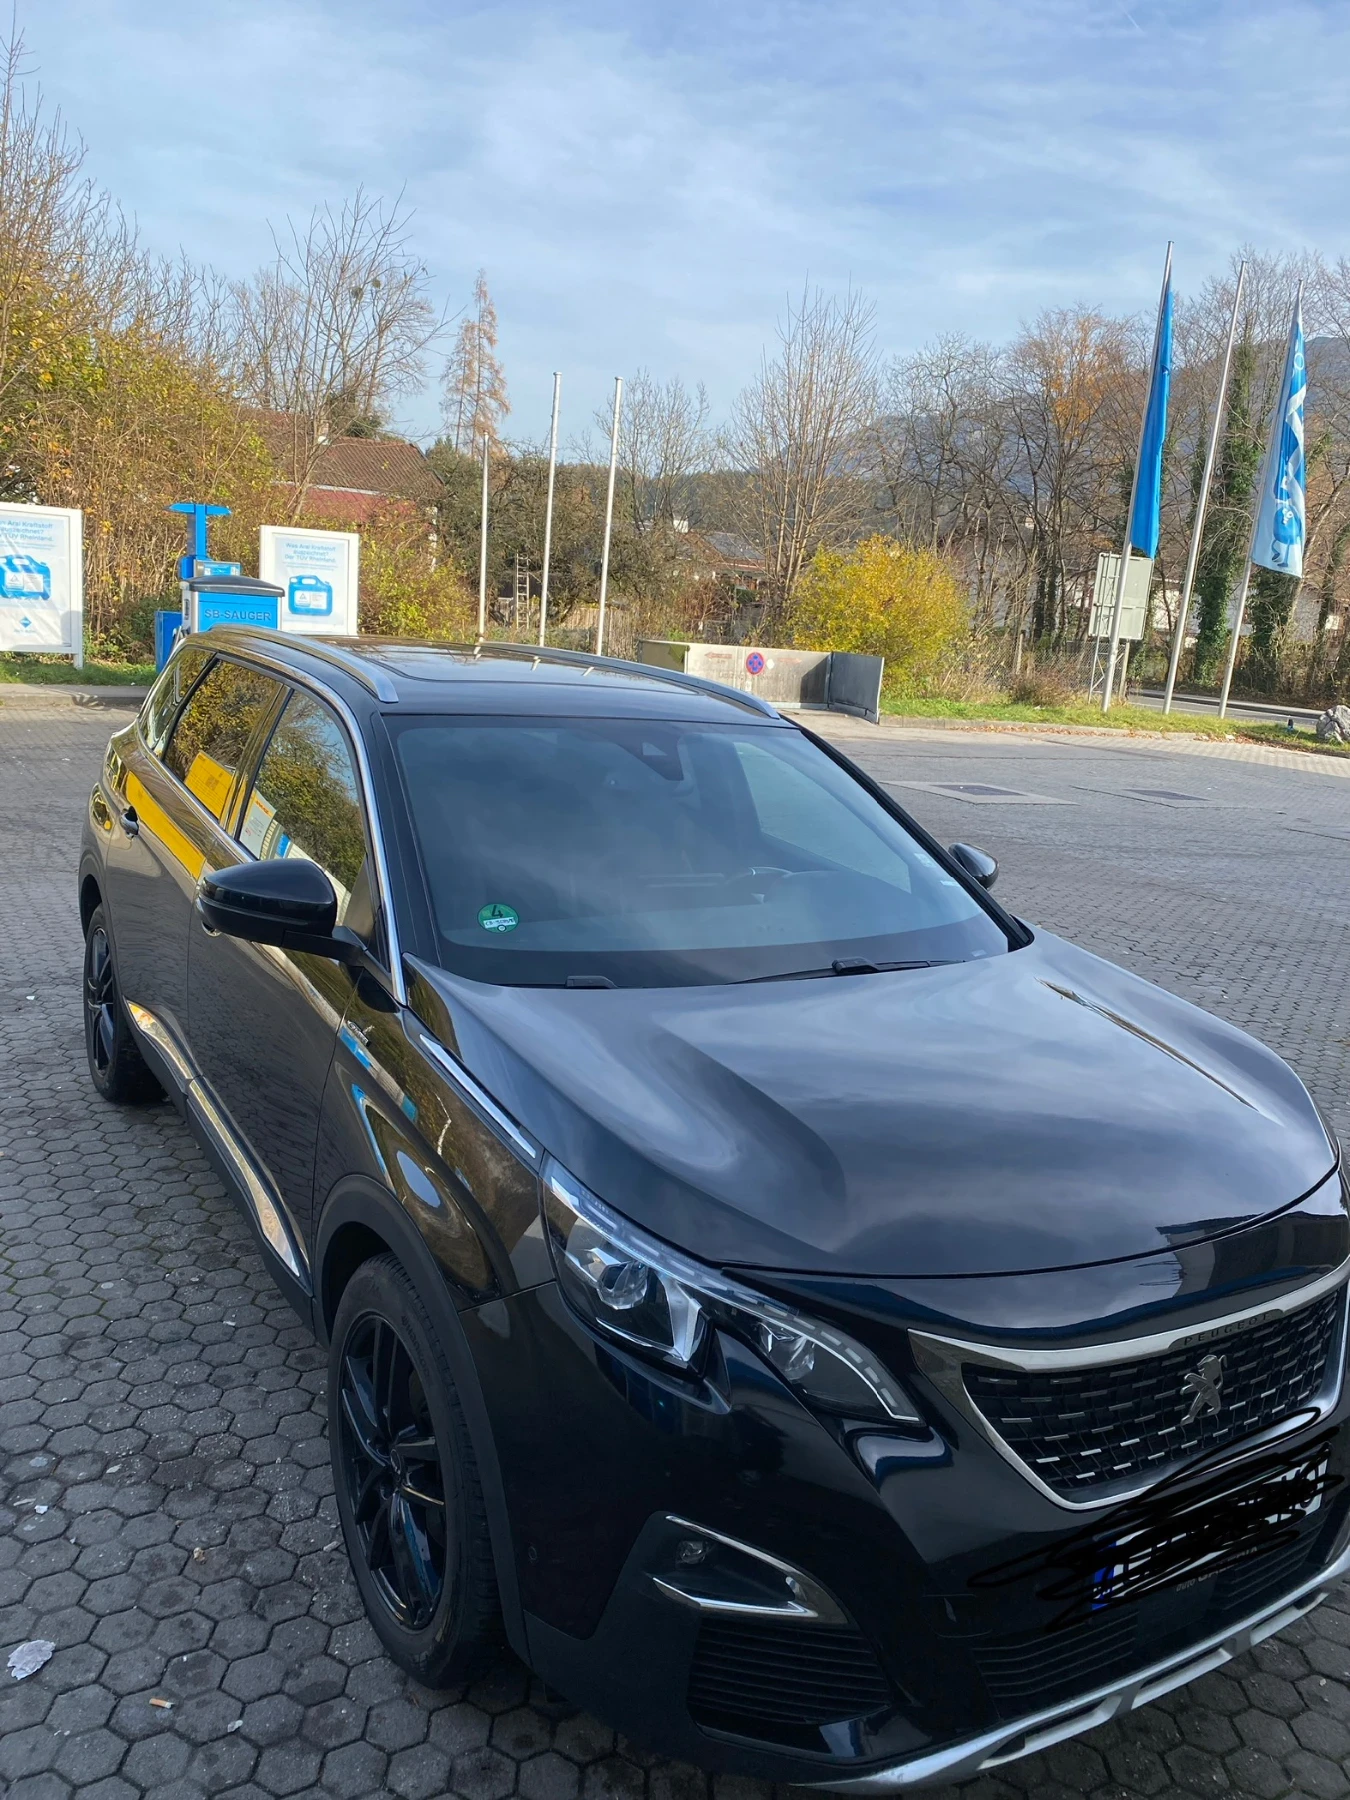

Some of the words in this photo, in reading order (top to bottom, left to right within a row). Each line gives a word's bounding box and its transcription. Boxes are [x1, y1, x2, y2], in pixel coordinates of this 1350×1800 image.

[204, 609, 271, 621] SB-SAUGER
[491, 904, 503, 918] 4
[1183, 1312, 1269, 1346] PEUGEOT
